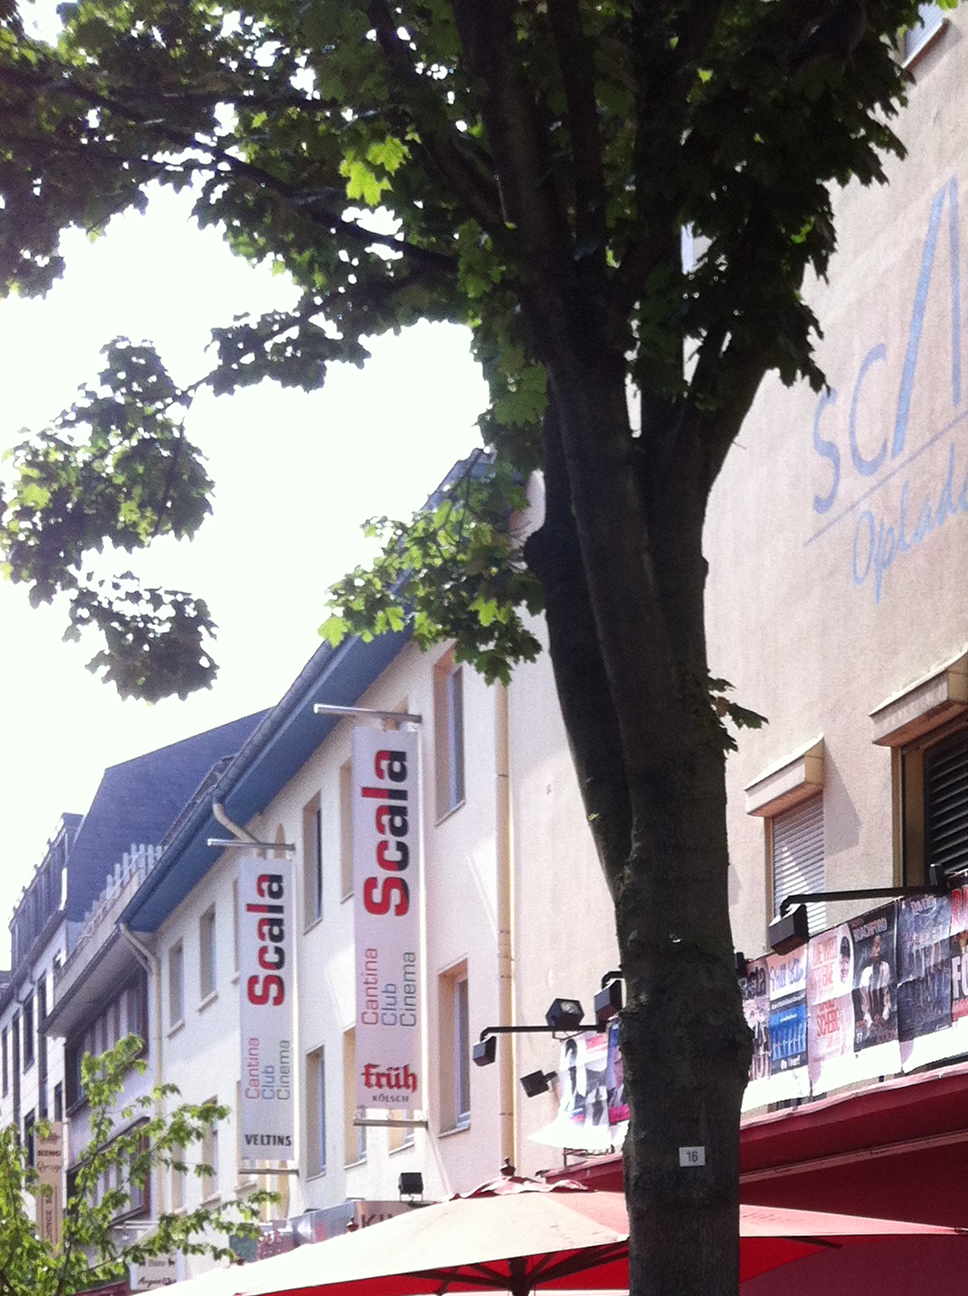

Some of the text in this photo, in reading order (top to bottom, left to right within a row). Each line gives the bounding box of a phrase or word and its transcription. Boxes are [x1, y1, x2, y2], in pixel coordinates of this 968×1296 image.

[361, 749, 410, 917] Scala
[247, 873, 285, 1007] Scala
[361, 947, 378, 1026] Cantina
[381, 983, 397, 1026] Club
[400, 951, 416, 1028] Cinema
[245, 1037, 260, 1100] Cantina
[261, 1065, 275, 1100] Club
[276, 1039, 290, 1101] Cinema
[361, 1063, 417, 1094] früh
[244, 1133, 292, 1147] VELTINS
[686, 1150, 698, 1162] 16
